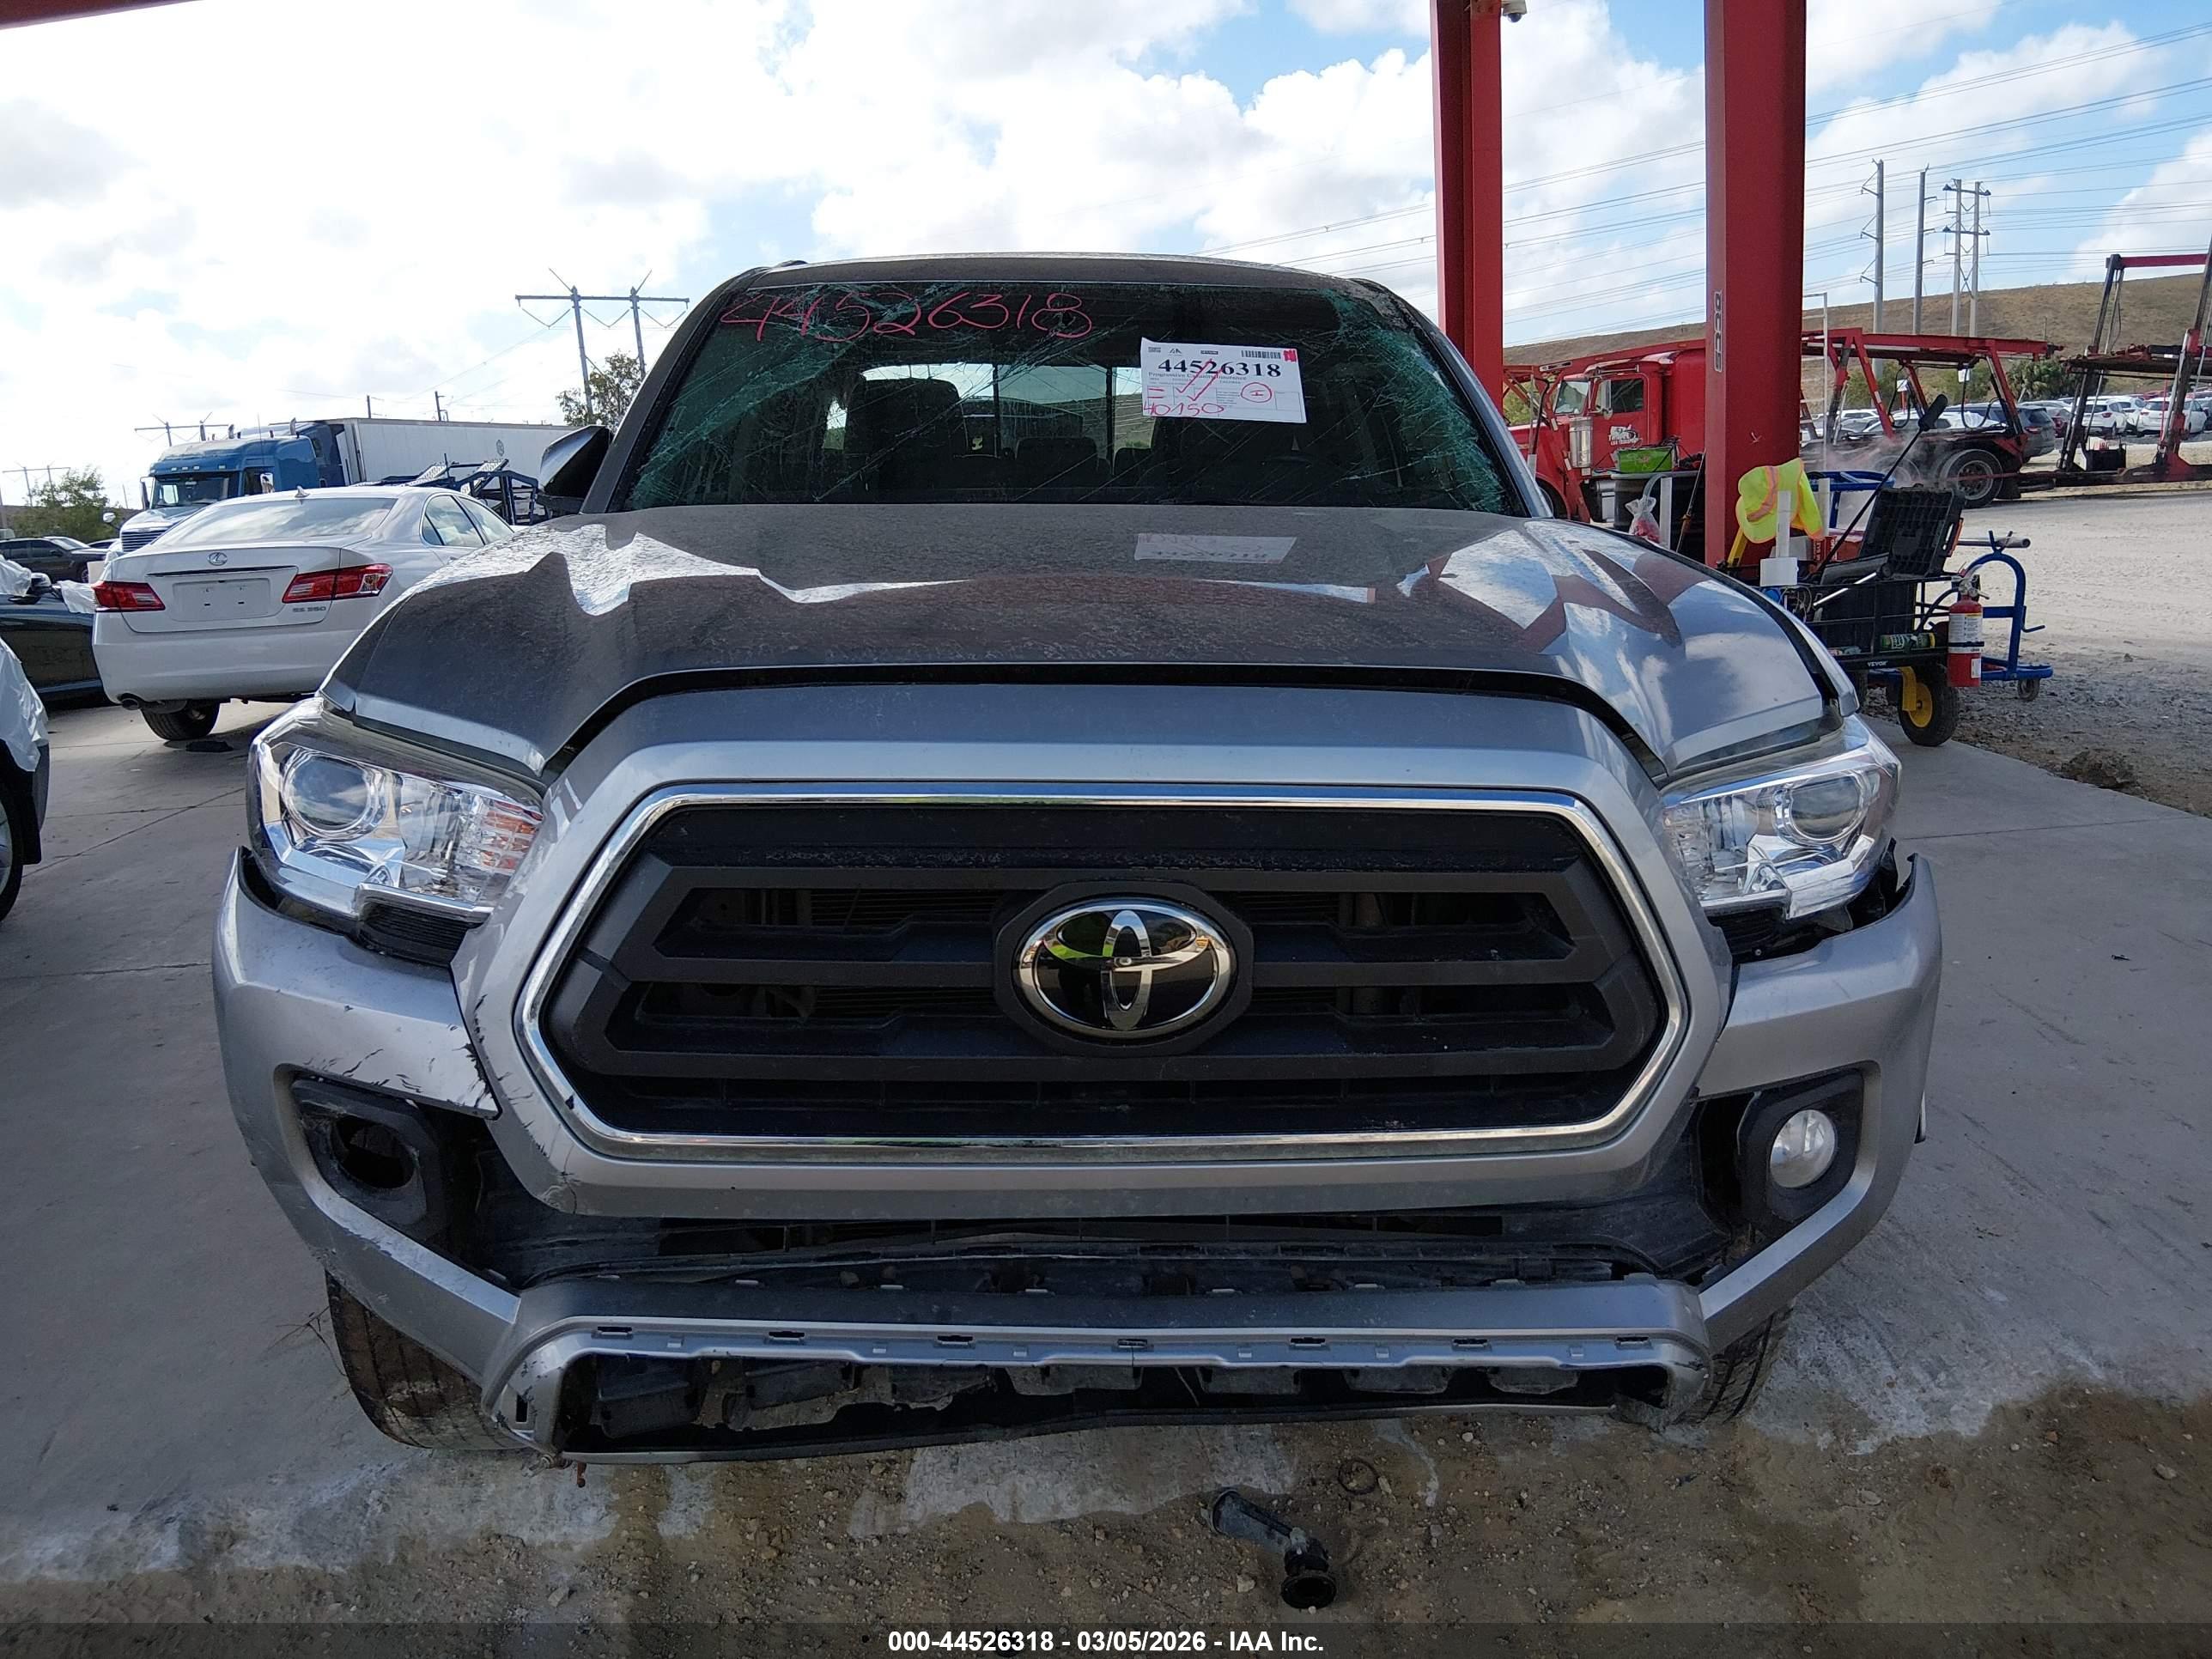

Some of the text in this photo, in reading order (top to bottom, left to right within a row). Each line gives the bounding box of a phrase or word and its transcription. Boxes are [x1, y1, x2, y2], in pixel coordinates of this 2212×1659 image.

[720, 291, 1092, 343] 44526318
[1158, 358, 1282, 378] 44526318
[1143, 400, 1224, 417] 40150
